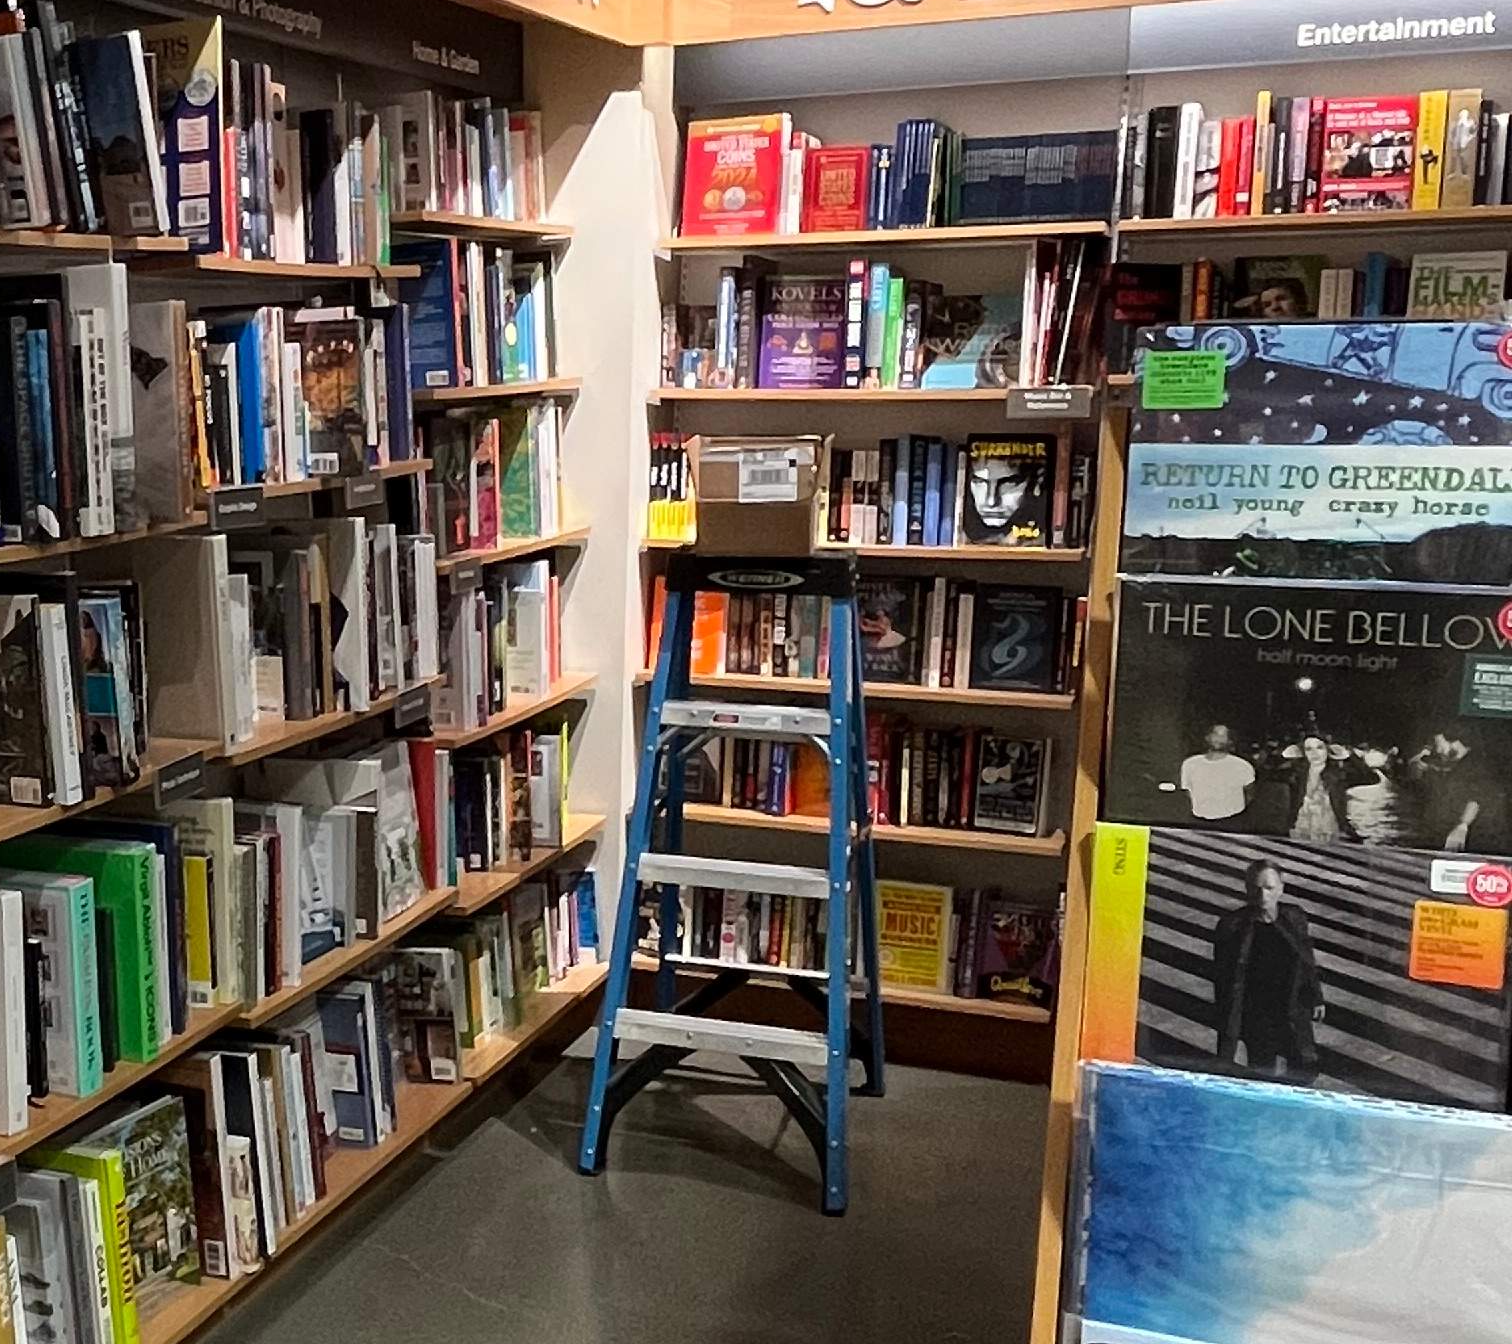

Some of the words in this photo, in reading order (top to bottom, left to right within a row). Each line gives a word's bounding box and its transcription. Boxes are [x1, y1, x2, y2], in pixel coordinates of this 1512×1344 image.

[1296, 10, 1497, 47] Entertainment
[771, 285, 843, 302] KOVELS
[1414, 275, 1501, 299] FILM-
[1139, 462, 1270, 490] RETURN
[1279, 463, 1319, 490] TO
[1328, 465, 1512, 494] GREENDAL
[1167, 493, 1220, 512] neil
[1232, 496, 1305, 517] young
[1328, 497, 1400, 518] crazy
[1411, 495, 1491, 518] horse
[1141, 601, 1215, 639] THE
[1223, 604, 1337, 644] LONE
[1295, 652, 1353, 668] moon
[1355, 653, 1400, 673] light
[1112, 836, 1128, 878] STING
[138, 855, 151, 900] Virgil
[884, 911, 937, 937] MUSIC
